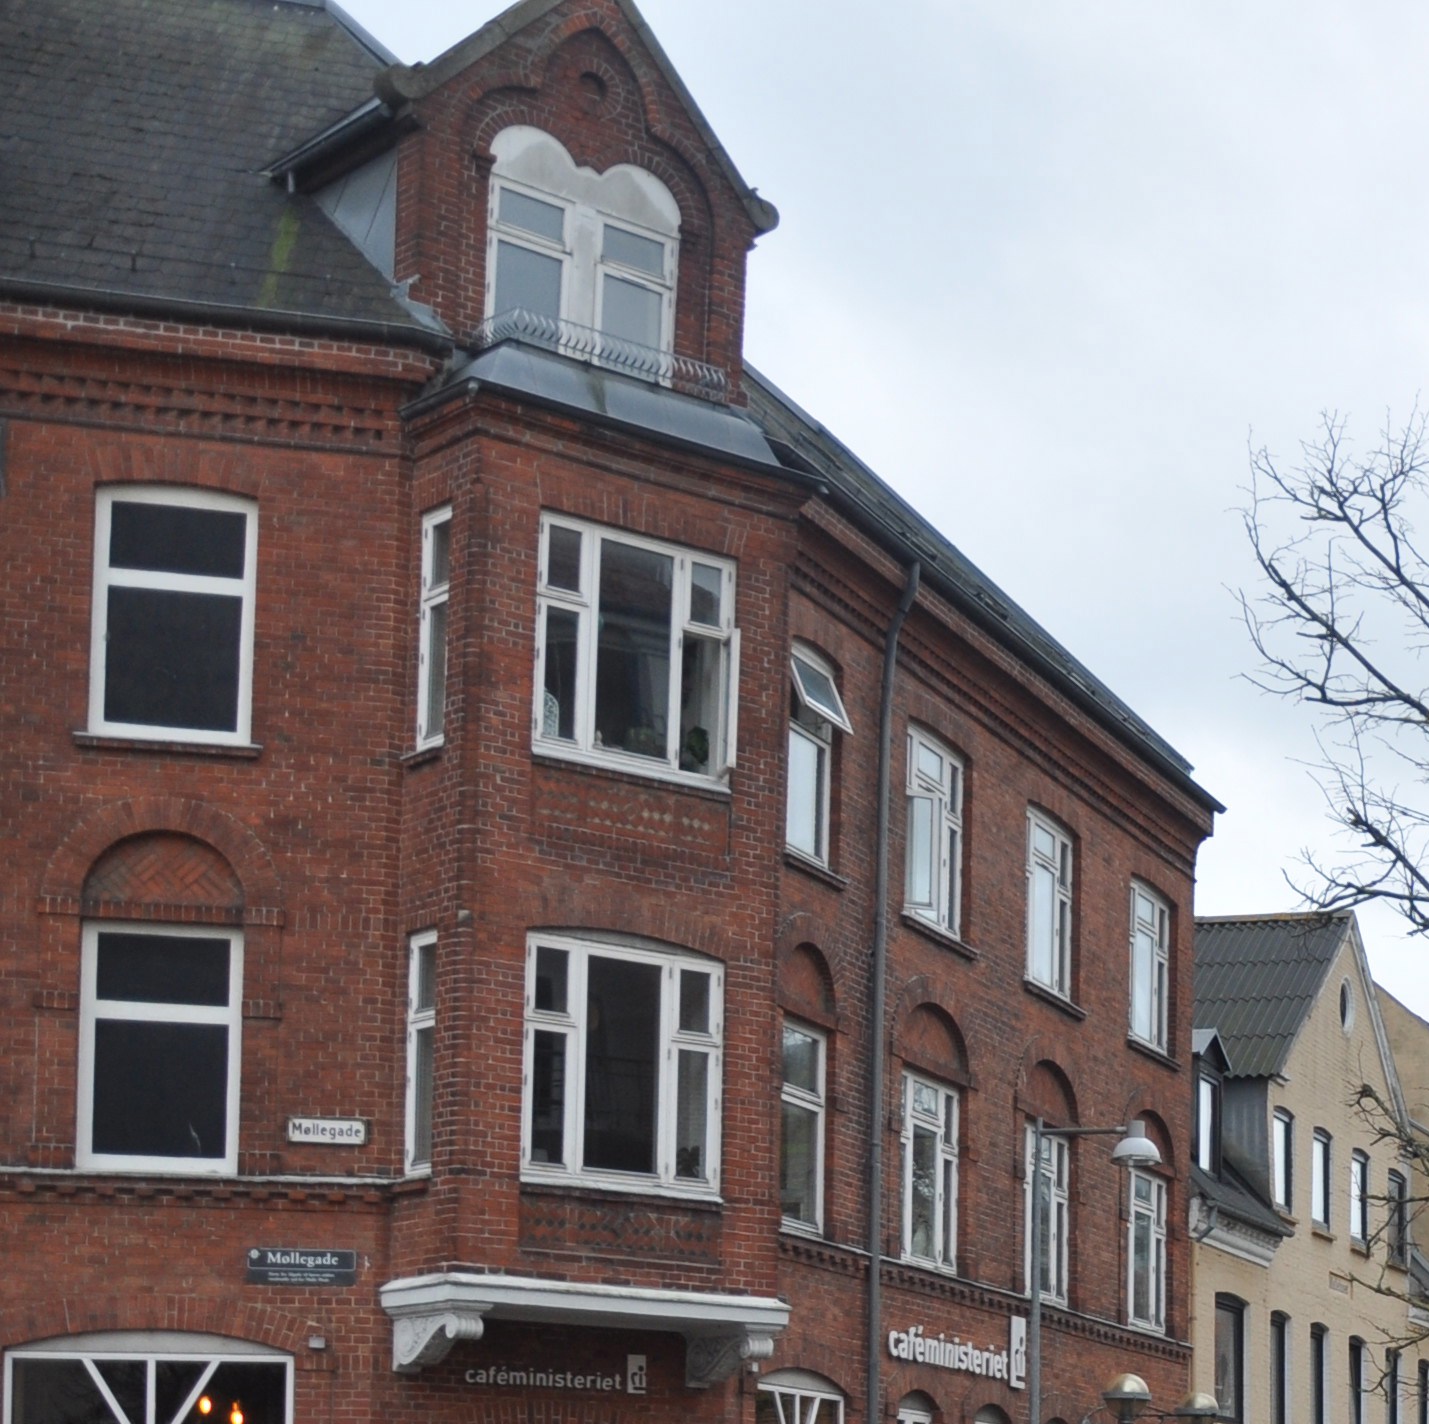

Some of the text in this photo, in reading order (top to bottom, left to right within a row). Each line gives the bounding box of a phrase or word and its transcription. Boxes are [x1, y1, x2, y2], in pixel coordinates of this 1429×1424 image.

[292, 1122, 361, 1139] Møllegade
[267, 1252, 339, 1267] Møllegade
[888, 1325, 1009, 1380] caféministeriet
[465, 1366, 622, 1390] caféministeriet
